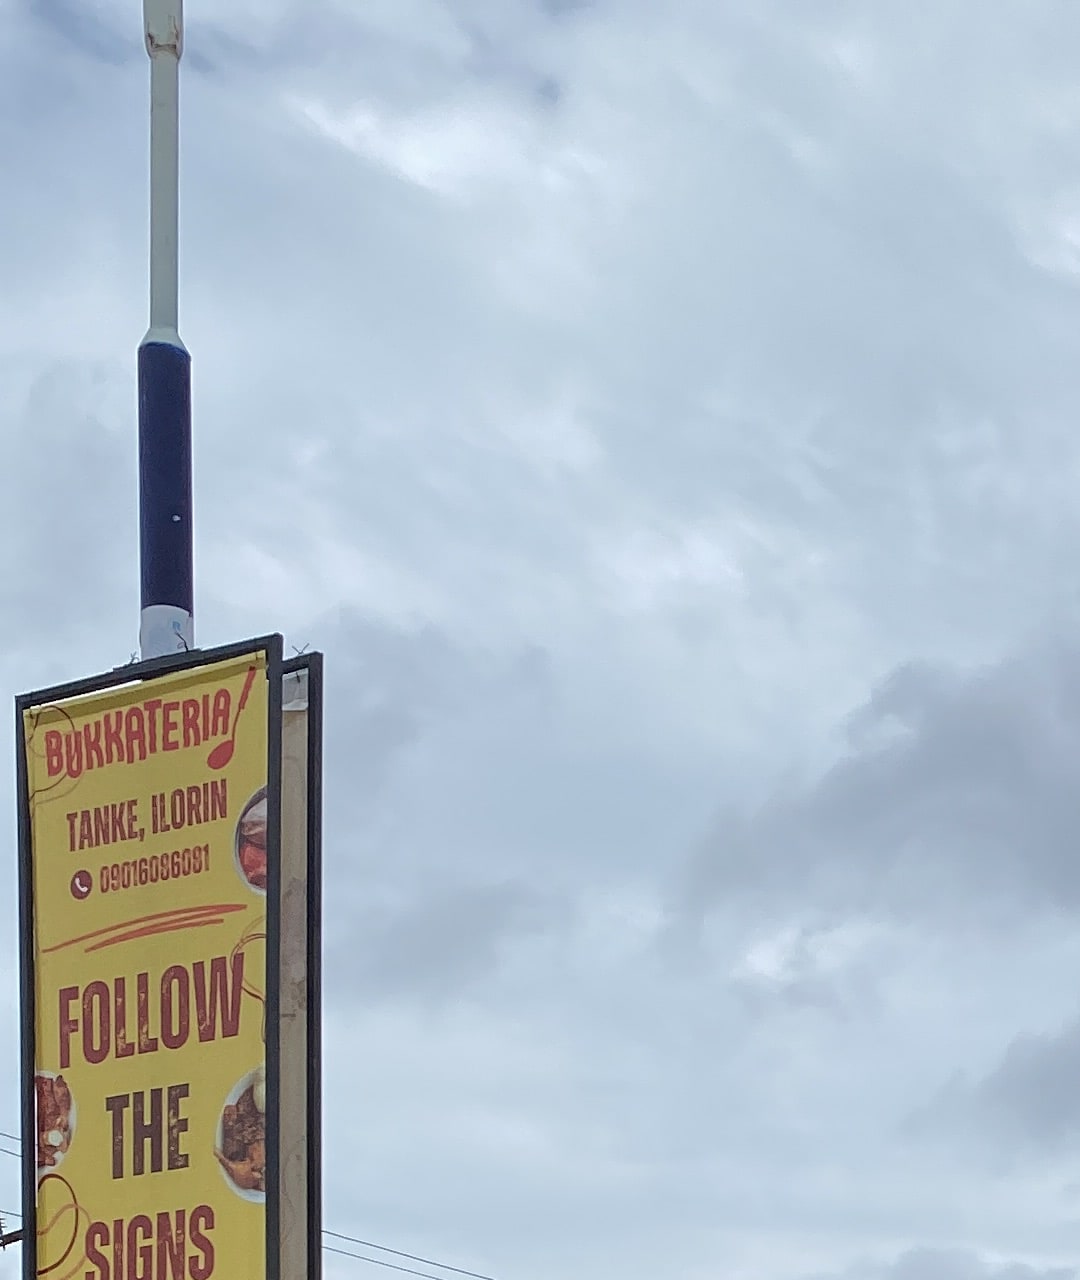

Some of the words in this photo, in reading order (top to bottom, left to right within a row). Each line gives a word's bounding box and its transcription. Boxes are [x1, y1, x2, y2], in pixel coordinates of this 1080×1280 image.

[45, 687, 232, 779] BUKKATERIA
[66, 799, 145, 852] TANKE,
[151, 778, 229, 834] ILORIN
[58, 952, 245, 1068] FOLLOW
[106, 1083, 190, 1180] THE
